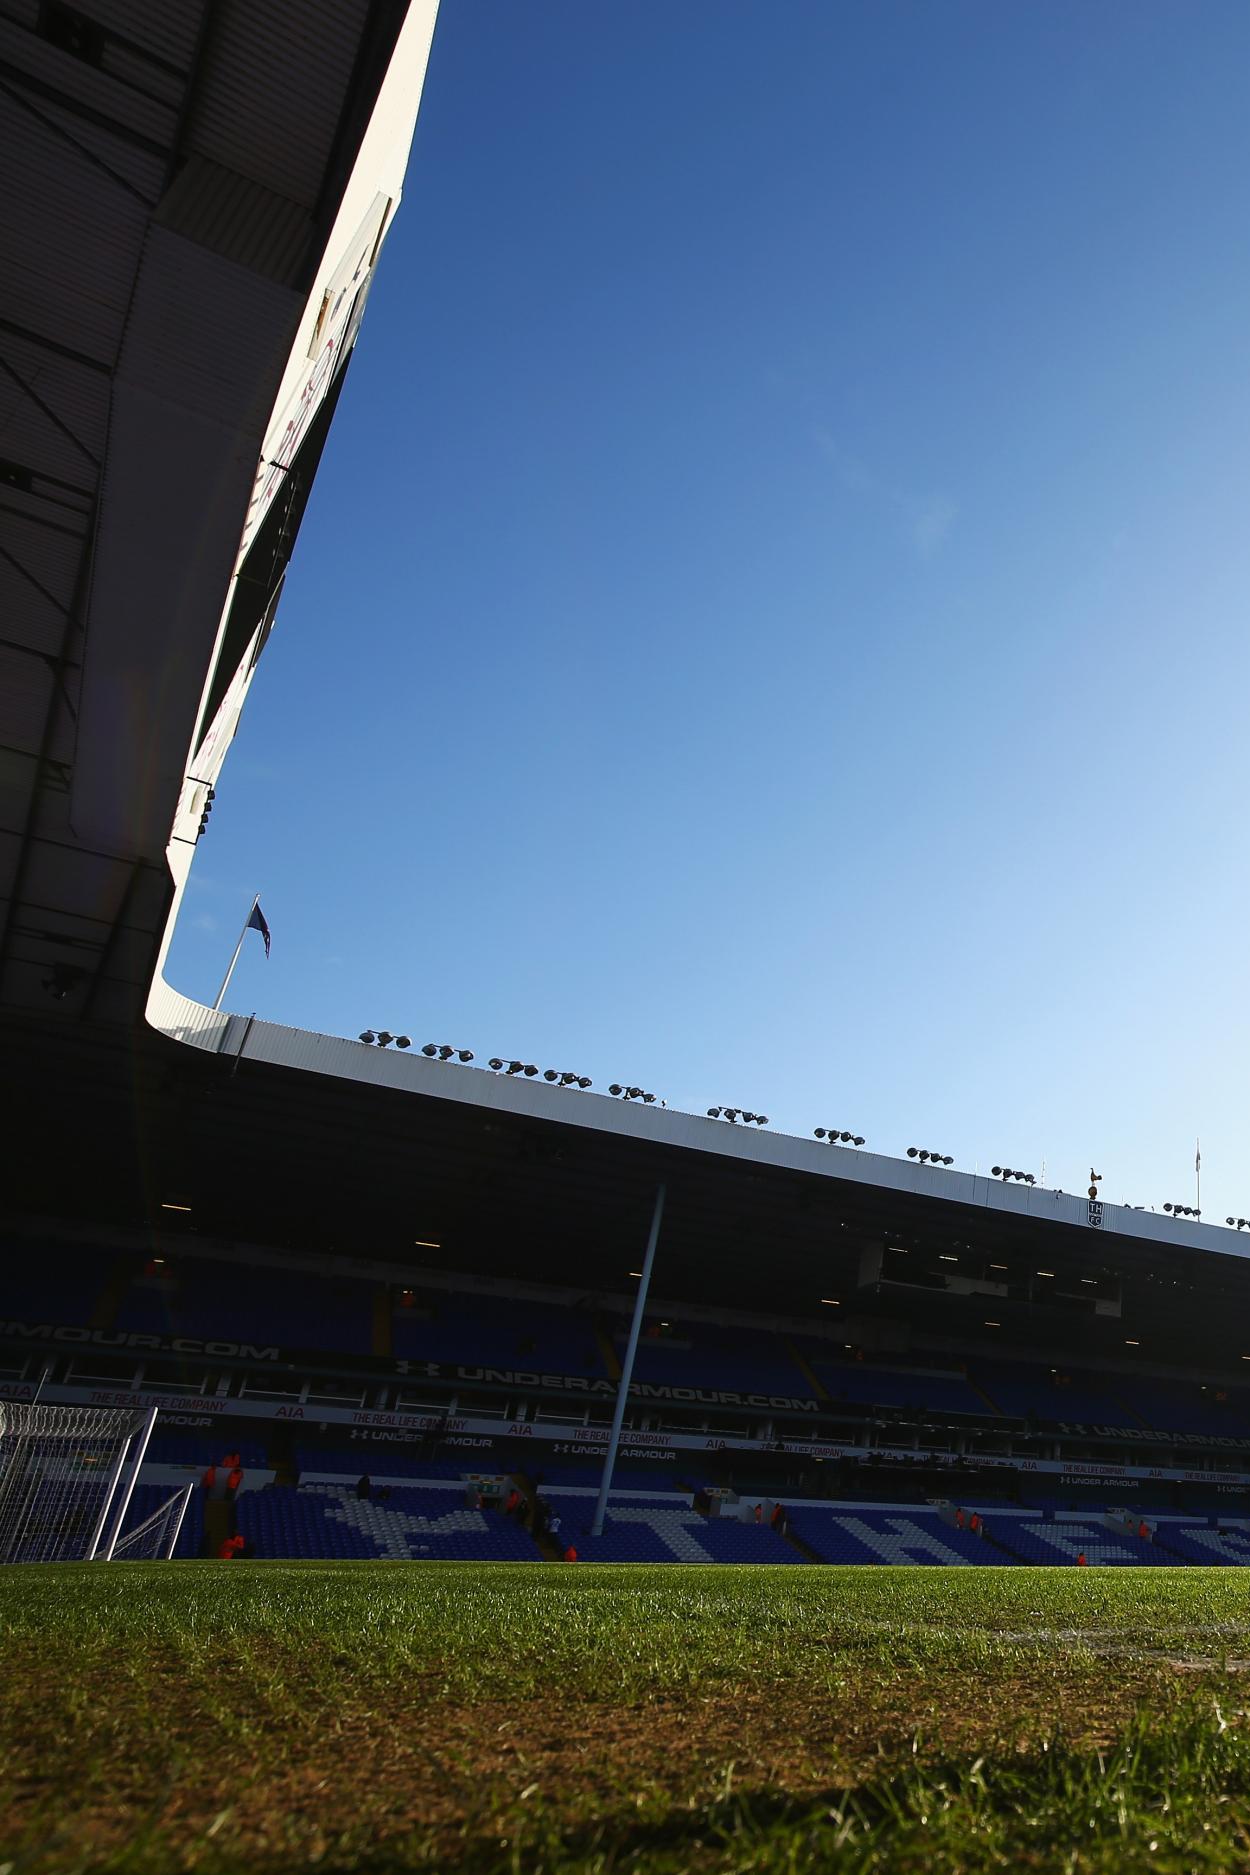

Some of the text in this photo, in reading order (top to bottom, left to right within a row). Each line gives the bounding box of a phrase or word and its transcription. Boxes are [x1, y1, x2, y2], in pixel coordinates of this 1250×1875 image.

[1090, 1203, 1102, 1214] TH
[1090, 1216, 1101, 1225] FC
[457, 1366, 820, 1412] UNDERARMOUR.COM
[90, 1391, 112, 1402] THE
[114, 1393, 141, 1405] REAL
[170, 1397, 227, 1412] COMPANY
[159, 1415, 213, 1427] MOUR
[275, 1406, 304, 1418] AIA
[352, 1412, 371, 1423] THE
[373, 1414, 397, 1425] REAL
[400, 1415, 418, 1427] LIFE
[372, 1430, 424, 1442] UNDER
[508, 1425, 533, 1435] AIA
[575, 1429, 589, 1439] THE
[590, 1430, 610, 1440] REAL
[631, 1434, 671, 1446] COMPANY
[706, 1439, 726, 1449] AIA
[571, 1446, 677, 1460] UNDE ARMOUR
[1022, 1461, 1038, 1470] AIA
[1148, 1469, 1162, 1478] AIA
[1071, 1477, 1138, 1487] UNDER ARMOUR
